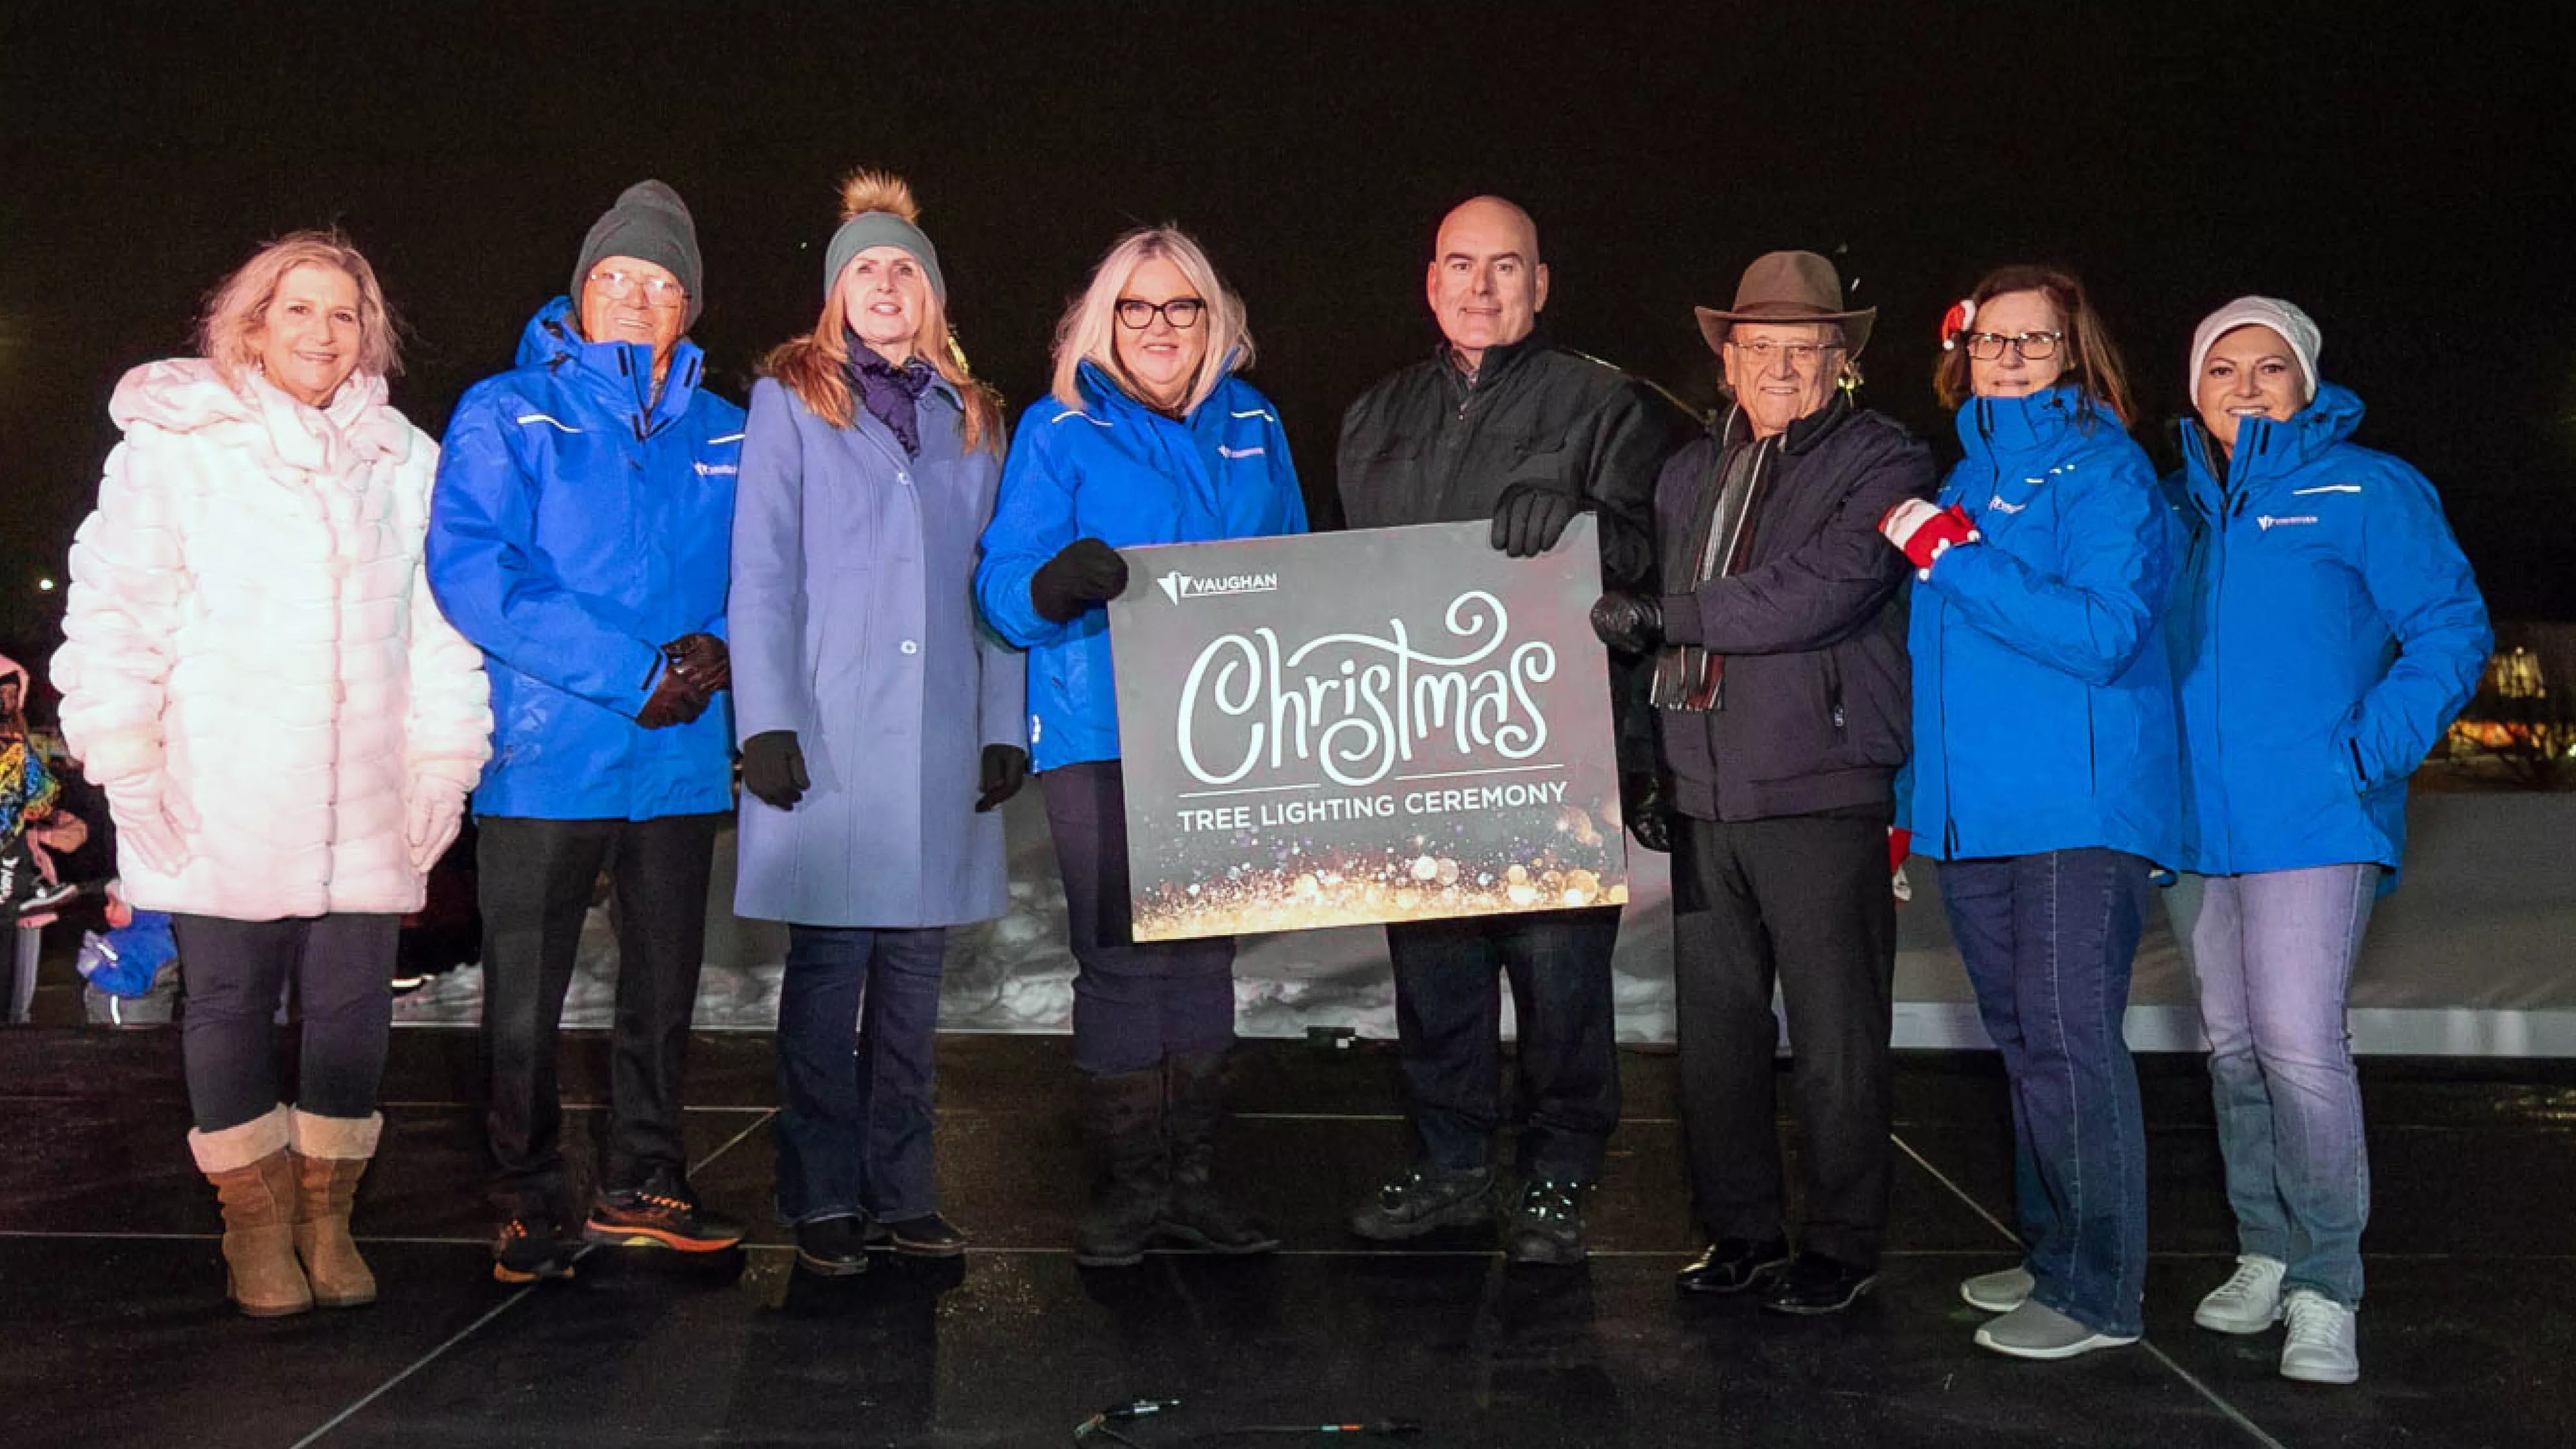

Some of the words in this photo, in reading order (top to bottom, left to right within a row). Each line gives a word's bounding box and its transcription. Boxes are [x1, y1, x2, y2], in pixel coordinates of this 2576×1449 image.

[1193, 572, 1278, 592] VAUGHAN
[1177, 591, 1556, 787] Christmas
[1176, 805, 1253, 832] TREE
[1260, 794, 1395, 826] LIGHTING
[1404, 781, 1568, 815] CEREMONY
